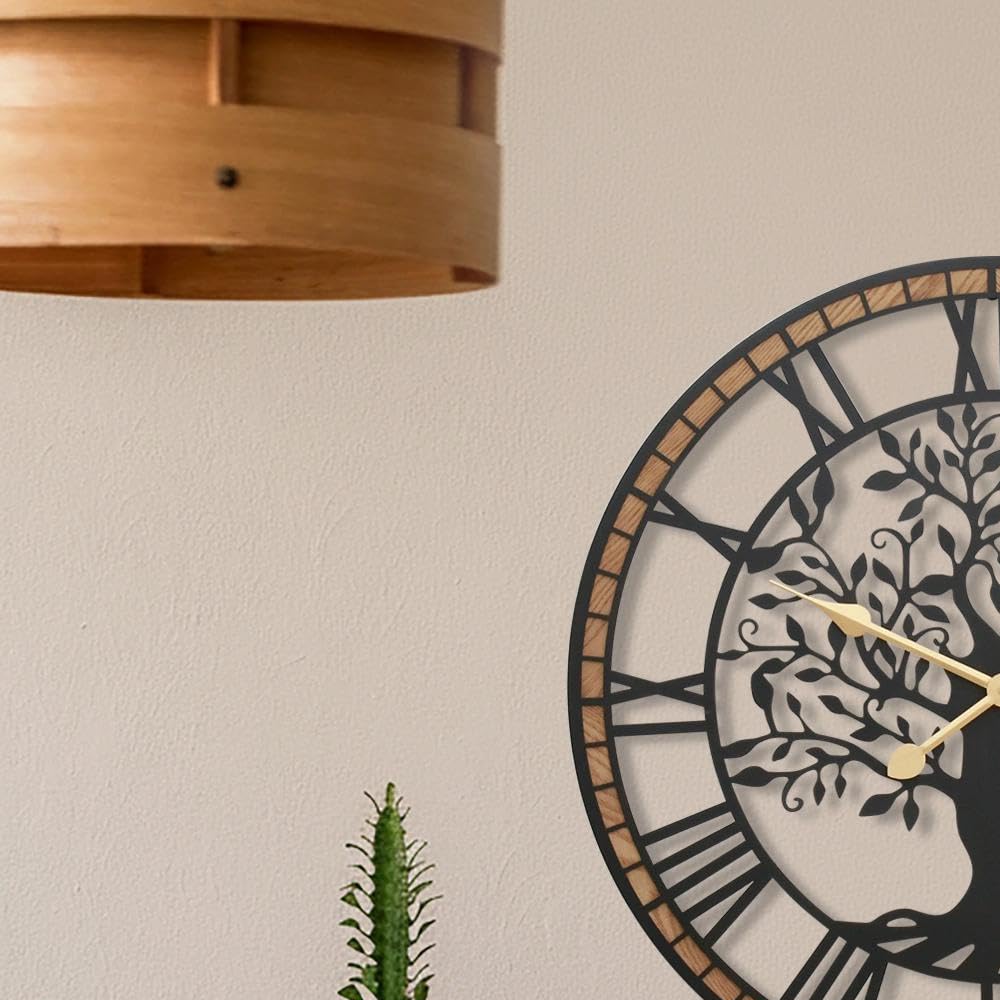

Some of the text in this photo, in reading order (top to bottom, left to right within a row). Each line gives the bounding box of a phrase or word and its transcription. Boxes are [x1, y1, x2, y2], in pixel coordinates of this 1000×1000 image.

[761, 342, 865, 453] XI
[645, 490, 753, 562] X
[610, 671, 707, 736] IX
[640, 802, 773, 948] VIII
